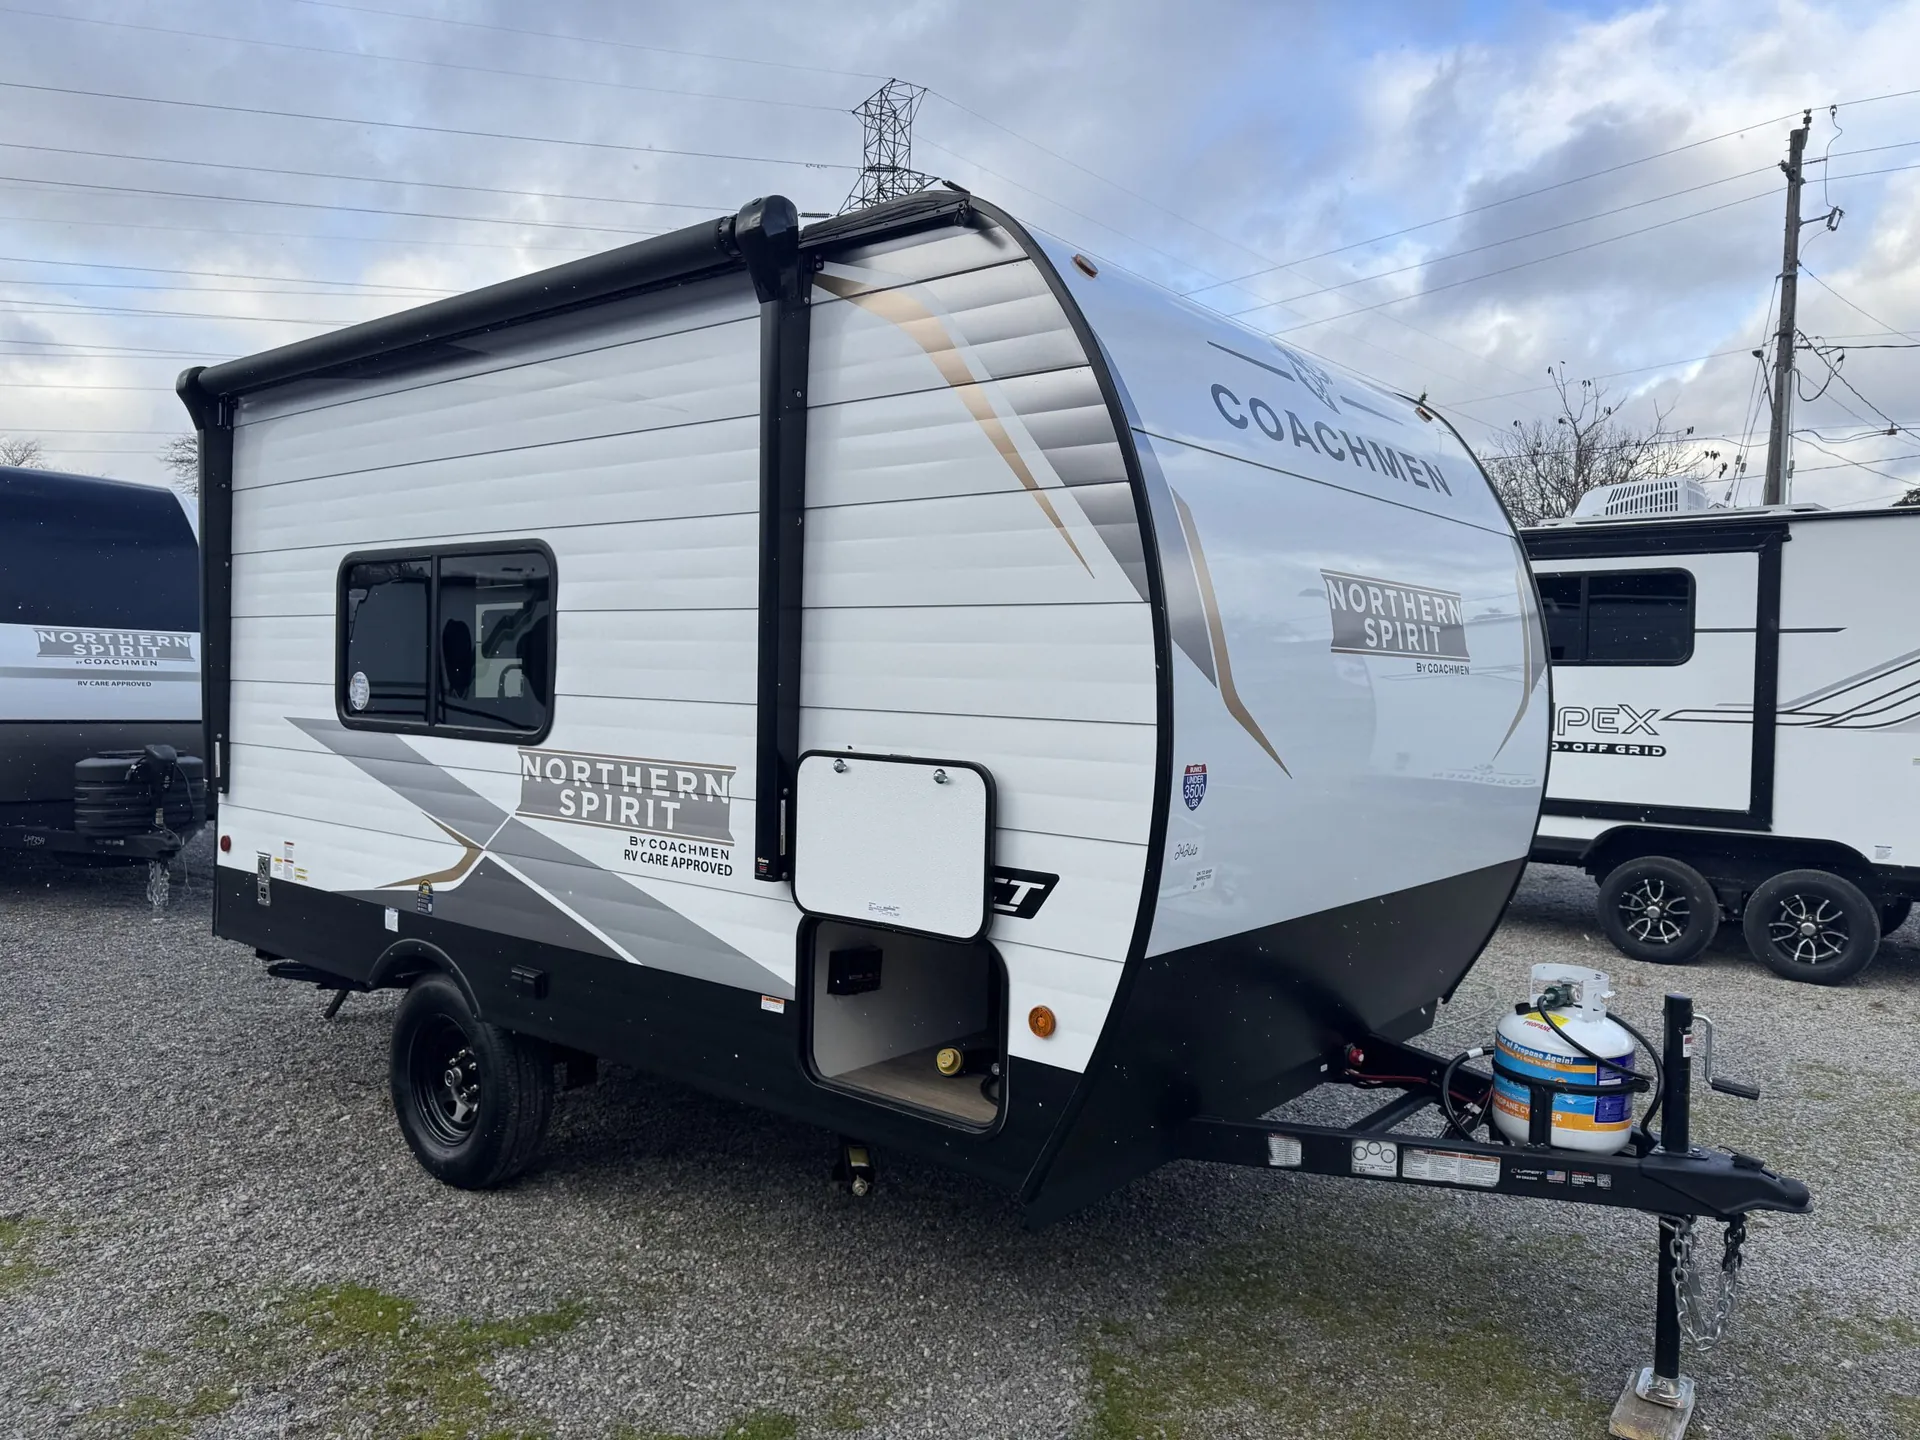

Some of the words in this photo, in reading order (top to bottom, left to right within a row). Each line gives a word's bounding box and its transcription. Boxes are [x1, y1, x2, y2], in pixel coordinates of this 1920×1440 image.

[1210, 383, 1453, 497] COACHMEN
[1325, 578, 1463, 626] NORTHERN
[37, 631, 190, 648] NORTHERN
[1364, 617, 1441, 653] SPIRIT
[73, 644, 161, 657] SPIRIT
[84, 658, 158, 667] COACHMEN
[1416, 662, 1426, 673] BY
[1427, 662, 1470, 675] COACHMEN
[1557, 704, 1661, 735] PEX
[1572, 743, 1608, 753] OFF
[1615, 745, 1663, 756] GRID
[521, 754, 730, 804] NORTHERN
[1186, 775, 1204, 784] UNDER
[1184, 784, 1205, 799] 3500
[559, 788, 681, 830] SPIRIT
[1188, 799, 1199, 808] LBS
[629, 836, 647, 847] BY
[649, 838, 730, 861] COACHMEN
[623, 849, 638, 862] RV
[640, 851, 669, 867] CARE
[671, 854, 733, 877] APPROVED
[1523, 1020, 1552, 1033] PROPANE
[1513, 1043, 1544, 1060] Propane
[1545, 1054, 1574, 1065] Again!
